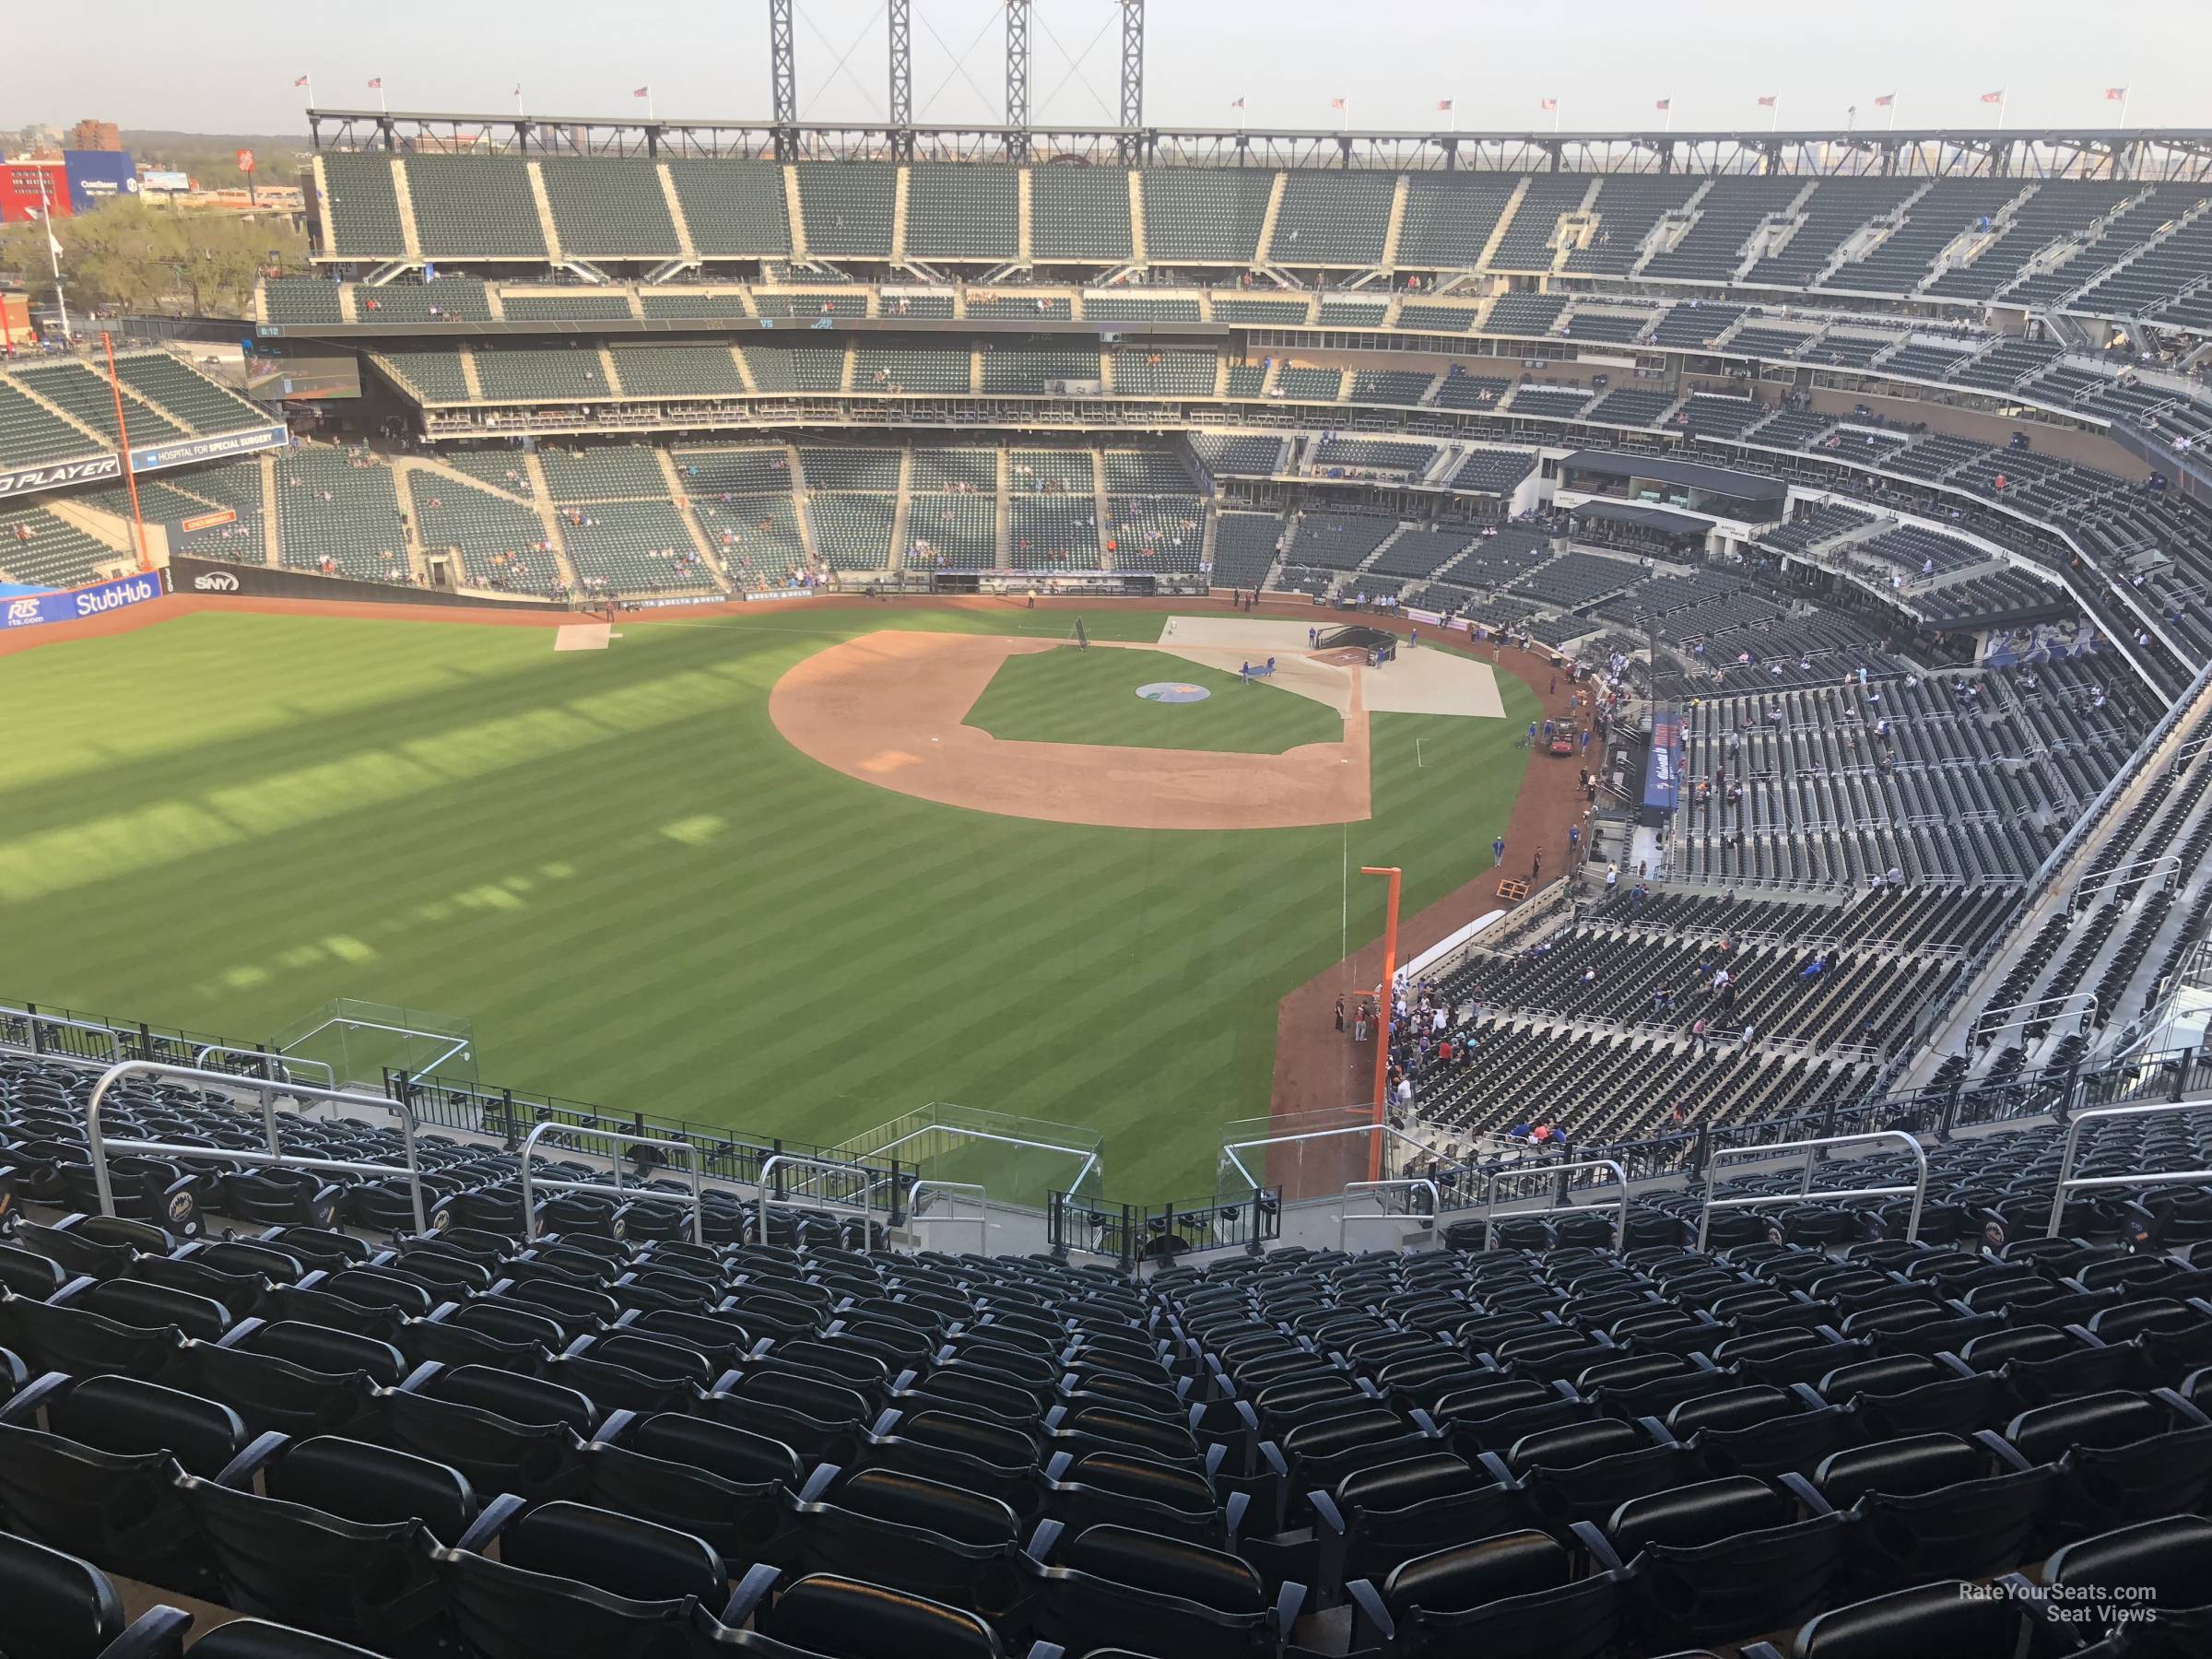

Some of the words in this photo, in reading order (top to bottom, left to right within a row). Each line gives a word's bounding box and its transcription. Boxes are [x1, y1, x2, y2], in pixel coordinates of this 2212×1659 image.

[158, 447, 194, 461] HOSPITAL
[194, 445, 208, 455] FOR
[208, 439, 240, 453] SPECIAL
[240, 432, 272, 447] SURGERY
[16, 460, 116, 488] PLAYER
[194, 576, 231, 591] SNY
[76, 580, 152, 617] StubHub
[665, 597, 690, 606] DELTA
[700, 595, 725, 604] DELTA
[755, 592, 778, 600] DELTA
[788, 590, 812, 598] DELTA
[8, 599, 40, 619] RTS
[8, 616, 44, 627] rts.com
